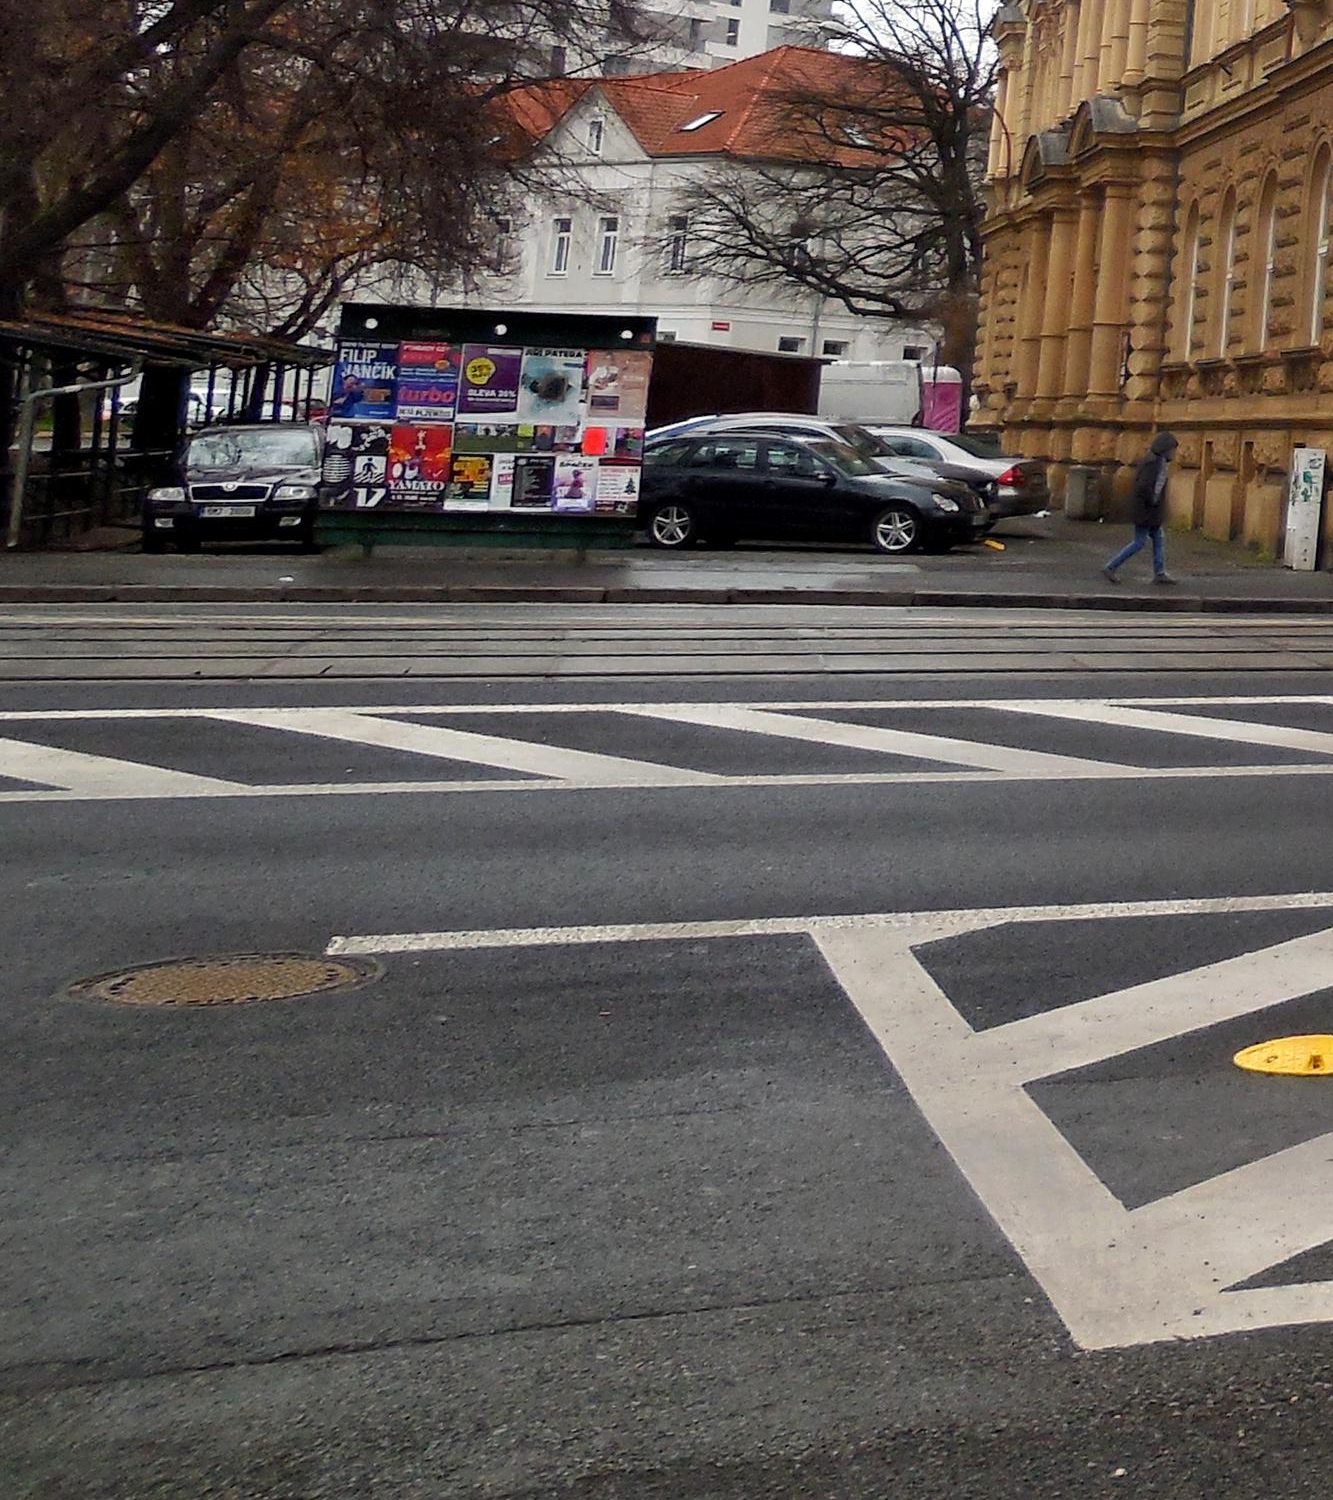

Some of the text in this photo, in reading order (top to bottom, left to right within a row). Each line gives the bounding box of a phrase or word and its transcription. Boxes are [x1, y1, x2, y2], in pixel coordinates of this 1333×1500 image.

[340, 349, 377, 363] FILIP
[341, 361, 397, 380] JANČÍK
[353, 487, 386, 508] 17
